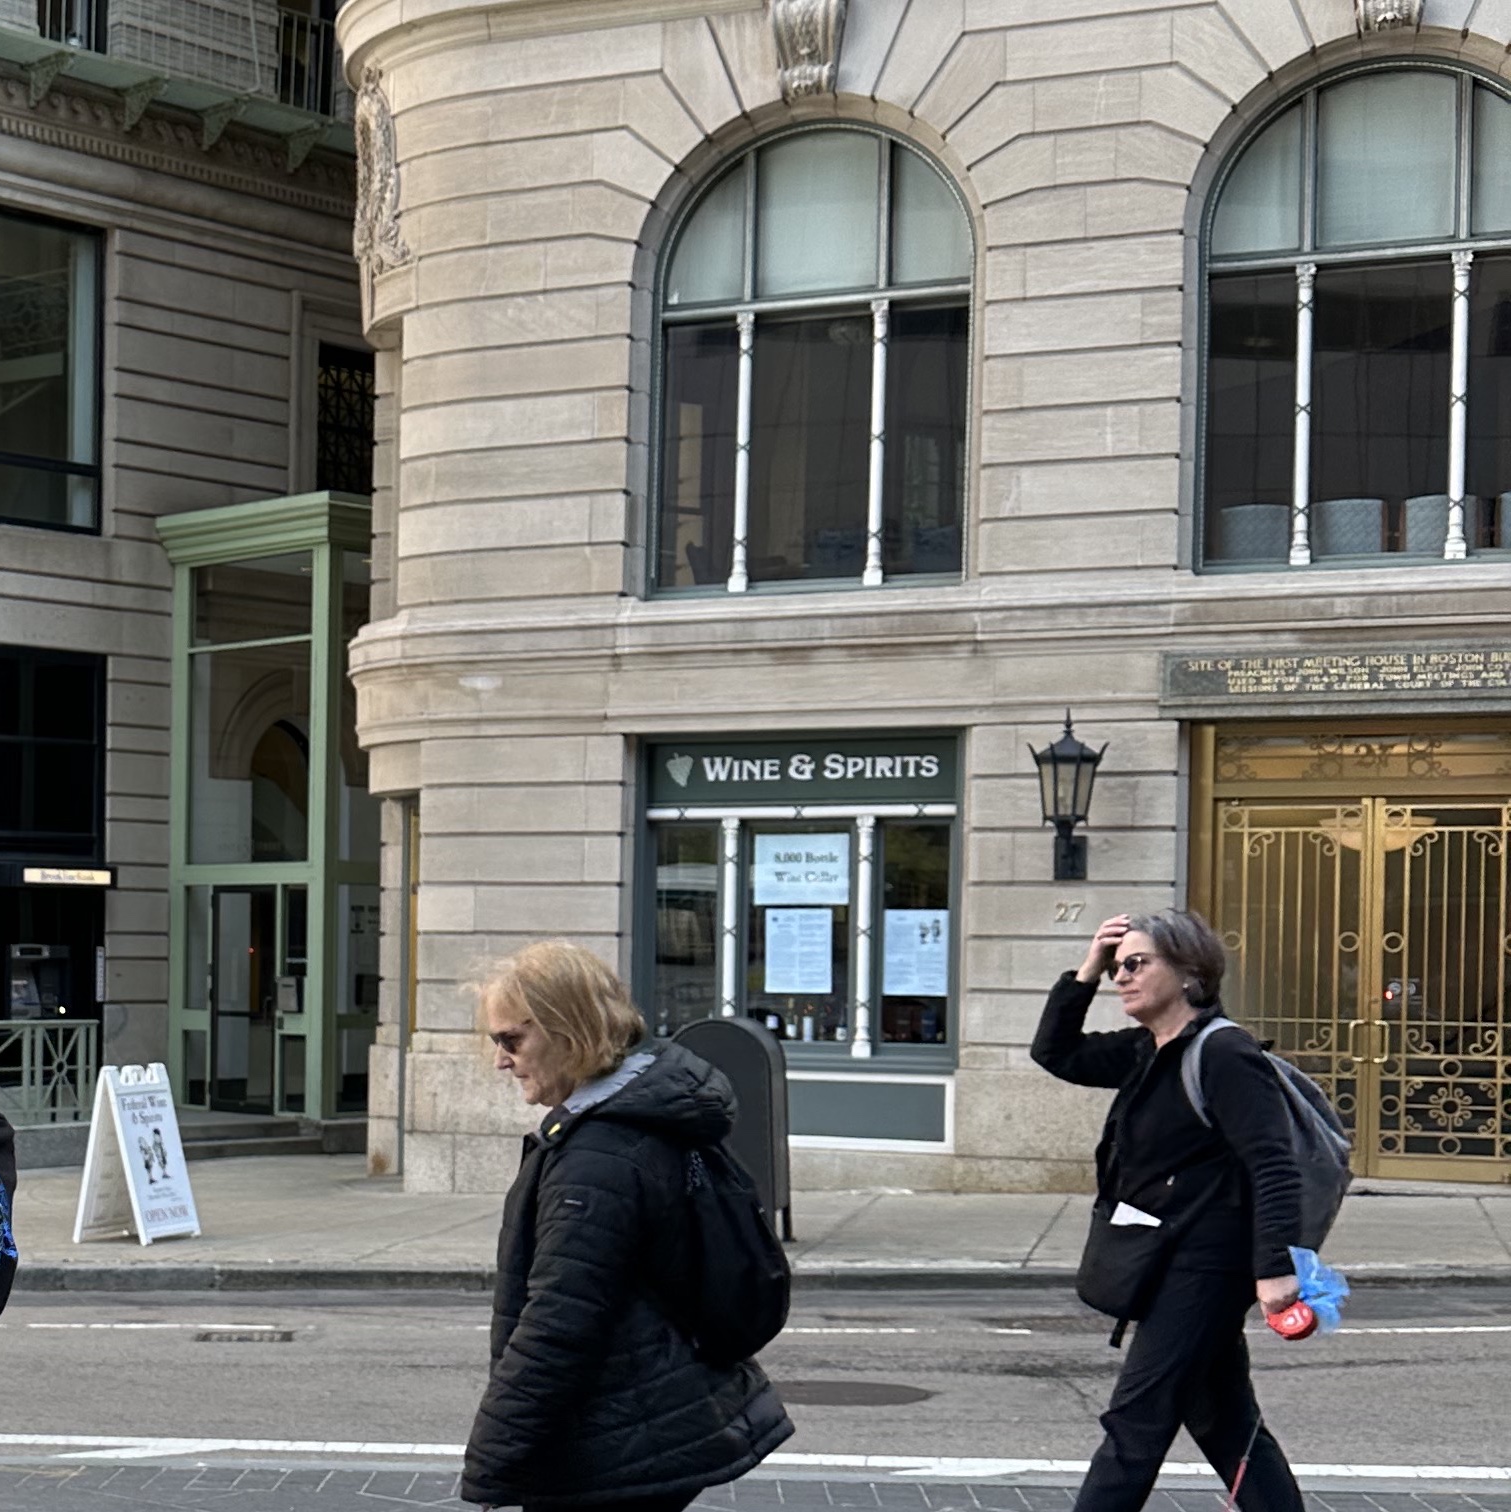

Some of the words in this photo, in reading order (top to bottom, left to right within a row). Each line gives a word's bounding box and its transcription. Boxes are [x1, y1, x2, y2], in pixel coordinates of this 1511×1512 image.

[1188, 660, 1215, 671] SITE
[1217, 659, 1235, 671] OF
[1240, 658, 1265, 669] THE
[1268, 657, 1300, 668] FIRST
[1303, 656, 1361, 668] MEETING
[1365, 655, 1408, 666] HOUSE
[1413, 653, 1426, 664] IN
[1429, 653, 1485, 664] BOSTON
[702, 756, 781, 782] WINE
[788, 753, 816, 781] &
[823, 753, 939, 780] SPIRITS
[1053, 901, 1086, 923] 27
[145, 1207, 168, 1221] OPEN
